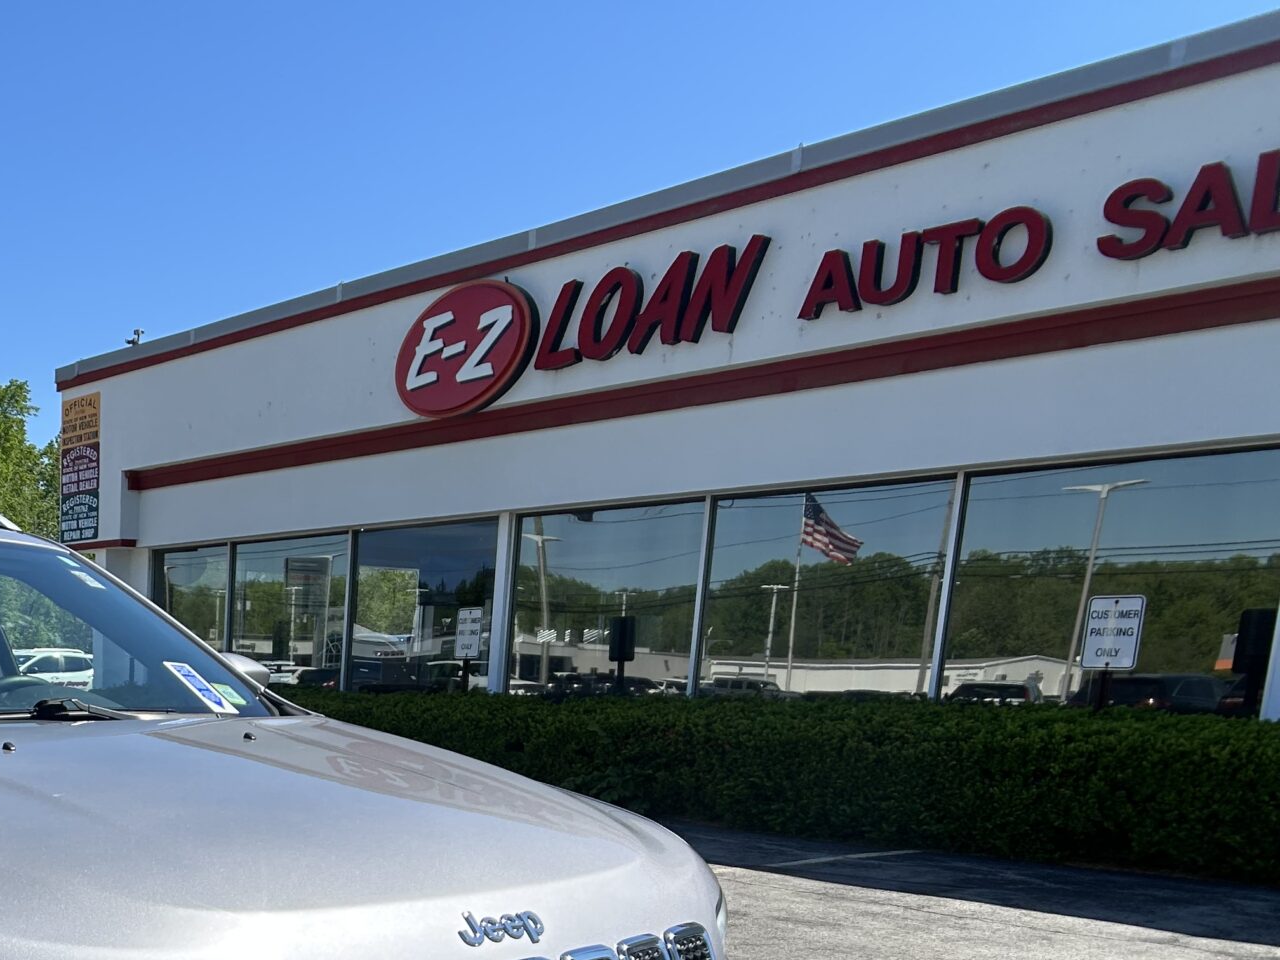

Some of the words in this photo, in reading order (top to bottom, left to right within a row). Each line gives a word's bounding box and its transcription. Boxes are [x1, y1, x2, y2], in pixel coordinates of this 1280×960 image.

[405, 304, 513, 391] E-Z
[534, 234, 771, 370] LOAN
[797, 206, 1053, 320] AUTO
[65, 397, 97, 417] OFFICIAL
[79, 418, 98, 430] VEHICLE
[63, 446, 97, 467] REGISTERED
[62, 472, 78, 484] MOTOR
[79, 468, 98, 480] VEHICLE
[79, 479, 97, 490] DEALER
[62, 494, 97, 513] REGISTERED
[62, 520, 77, 530] MOTOR
[79, 517, 97, 528] VEHICLE
[63, 530, 80, 541] REPAIR
[82, 528, 94, 539] SHOP
[1090, 609, 1139, 619] CUSOMER
[1090, 627, 1134, 637] PARKING
[1095, 647, 1120, 657] ONLY
[458, 910, 544, 947] Jeep
